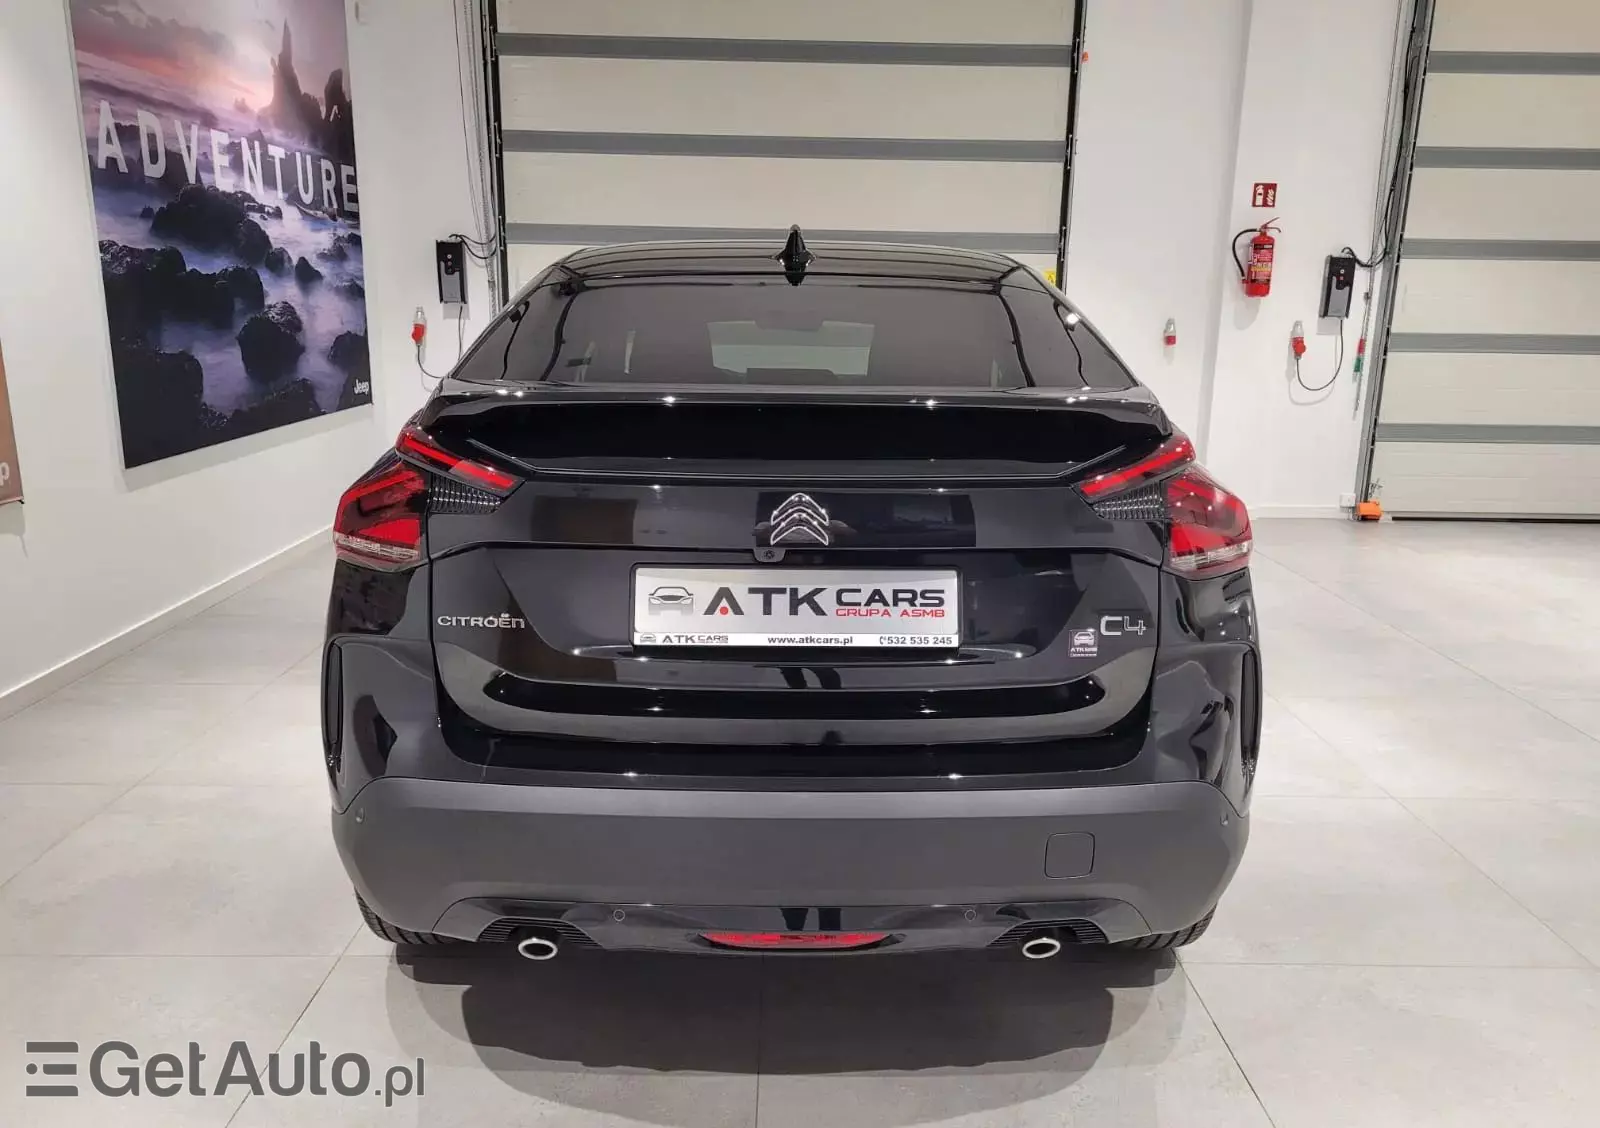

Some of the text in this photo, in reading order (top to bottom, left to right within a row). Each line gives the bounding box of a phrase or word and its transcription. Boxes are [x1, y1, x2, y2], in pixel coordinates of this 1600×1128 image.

[97, 100, 358, 212] ADVENTURE
[354, 378, 369, 395] Jeep
[703, 587, 945, 616] ATK CARS
[835, 608, 945, 618] GRUPA ASMB
[1100, 615, 1147, 636] C4
[662, 635, 697, 644] ATK
[767, 636, 853, 646] www.atkcars.pl
[887, 635, 953, 645] 532 535 245
